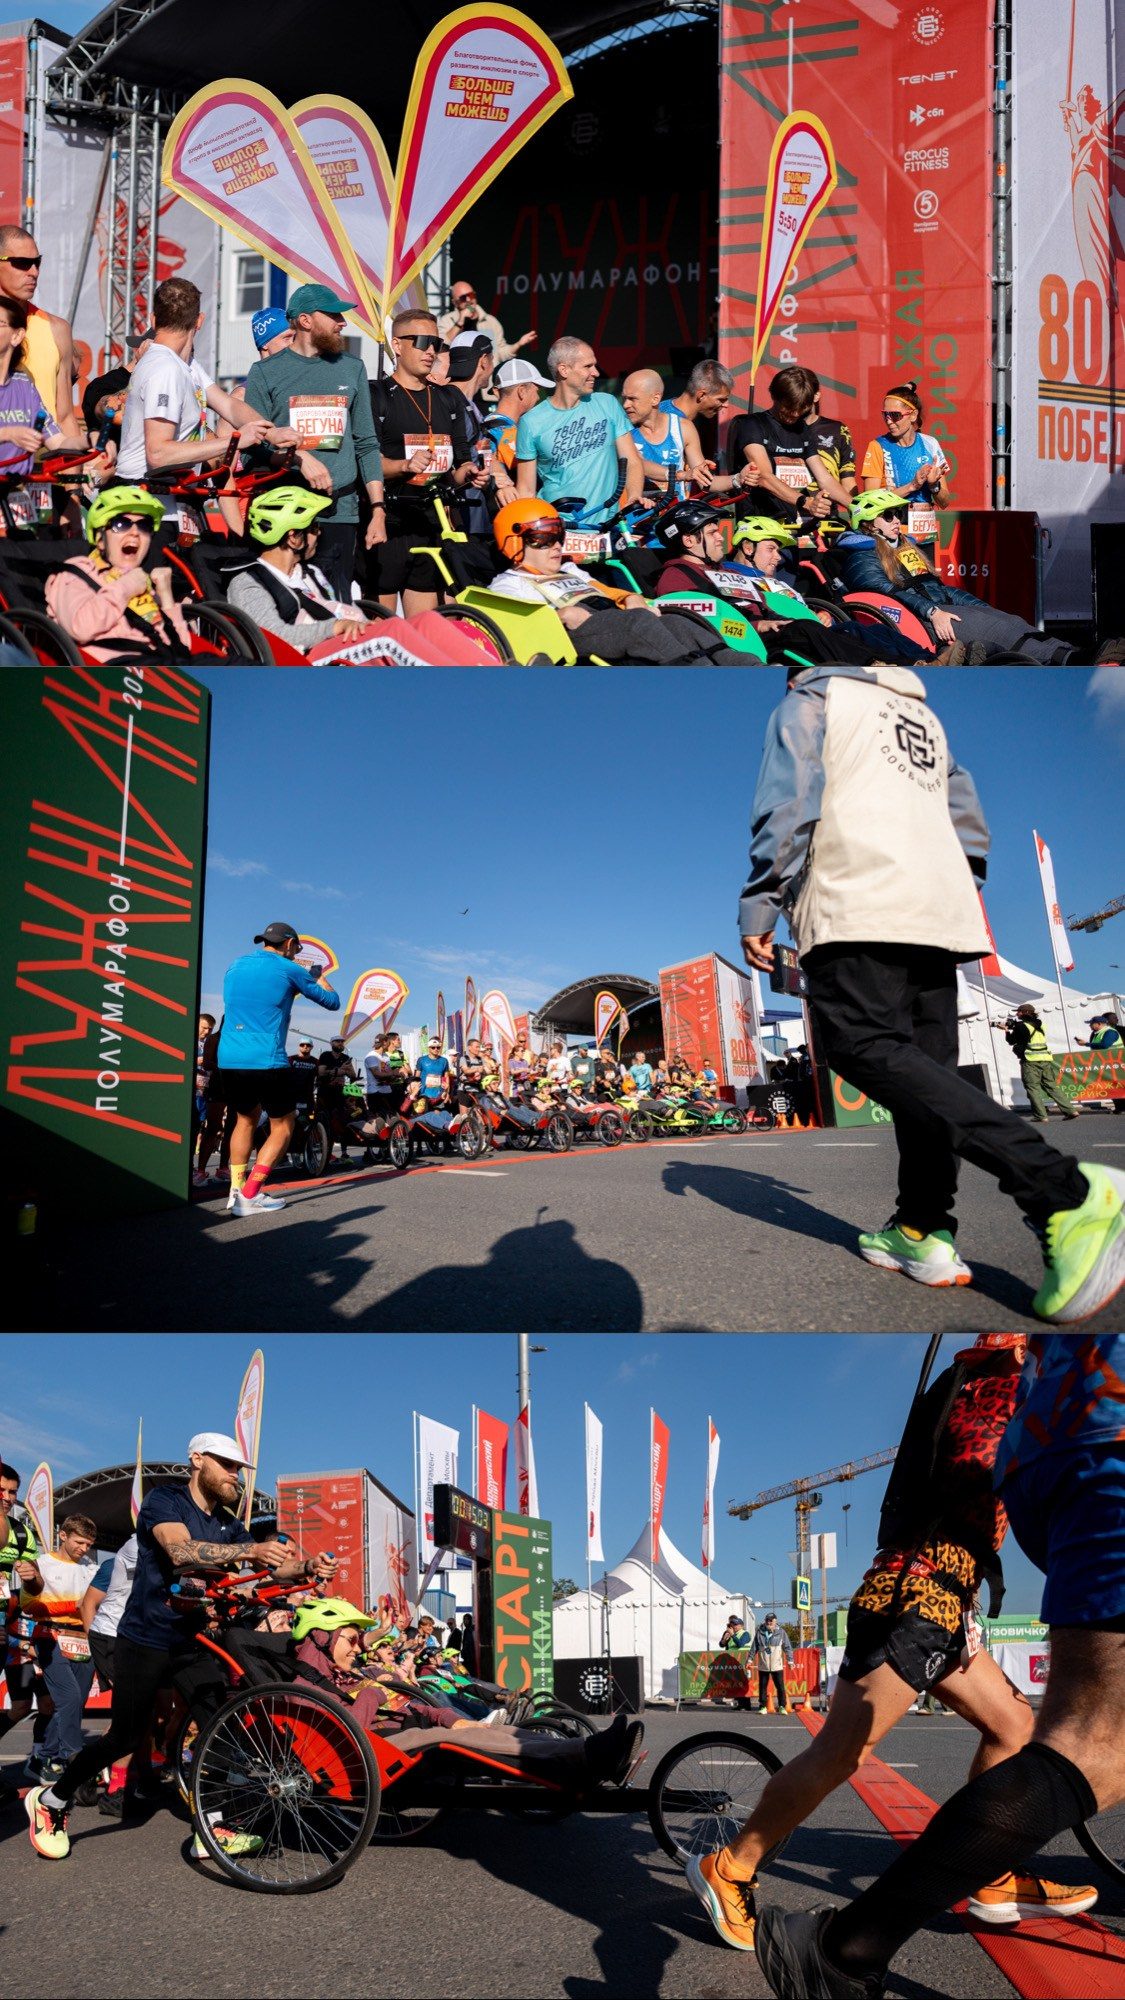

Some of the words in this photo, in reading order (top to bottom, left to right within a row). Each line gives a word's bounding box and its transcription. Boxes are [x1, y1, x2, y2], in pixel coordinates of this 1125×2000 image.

[454, 50, 518, 64] Благотворительный
[520, 58, 538, 68] фонд
[450, 61, 479, 70] развития
[480, 65, 512, 74] инклюзии
[518, 69, 540, 78] спорте
[453, 76, 513, 94] БОЛЬШЕ
[898, 70, 958, 86] TENET
[465, 91, 494, 105] ЧЕМ
[446, 103, 508, 120] МОЖЕШЬ
[927, 108, 944, 117] сбп
[904, 147, 949, 161] CROCUS
[904, 159, 949, 172] FITNESS
[778, 211, 797, 232] 5:50
[496, 261, 701, 295] ПОЛУМАРАФОН
[1038, 273, 1110, 386] 80
[296, 417, 344, 434] БЕГУНА
[1038, 405, 1125, 475] ПОБЕД
[565, 537, 607, 552] БЕГУНА
[946, 563, 989, 577] 2025
[714, 572, 747, 585] 2148
[724, 625, 743, 638] 1474
[95, 872, 132, 1112] ПОЛУМАРАФОН
[122, 667, 145, 712] 202
[1060, 1063, 1125, 1073] ПОЛУМАРАФО
[1056, 1082, 1124, 1093] РОДОЛЖА
[1065, 1090, 1108, 1099] ТОРИЮ
[296, 1487, 304, 1513] 2025
[494, 1512, 532, 1694] СТАРТ
[988, 1626, 1050, 1638] УЗОВИЧКО
[61, 1641, 90, 1654] БЕГУНА
